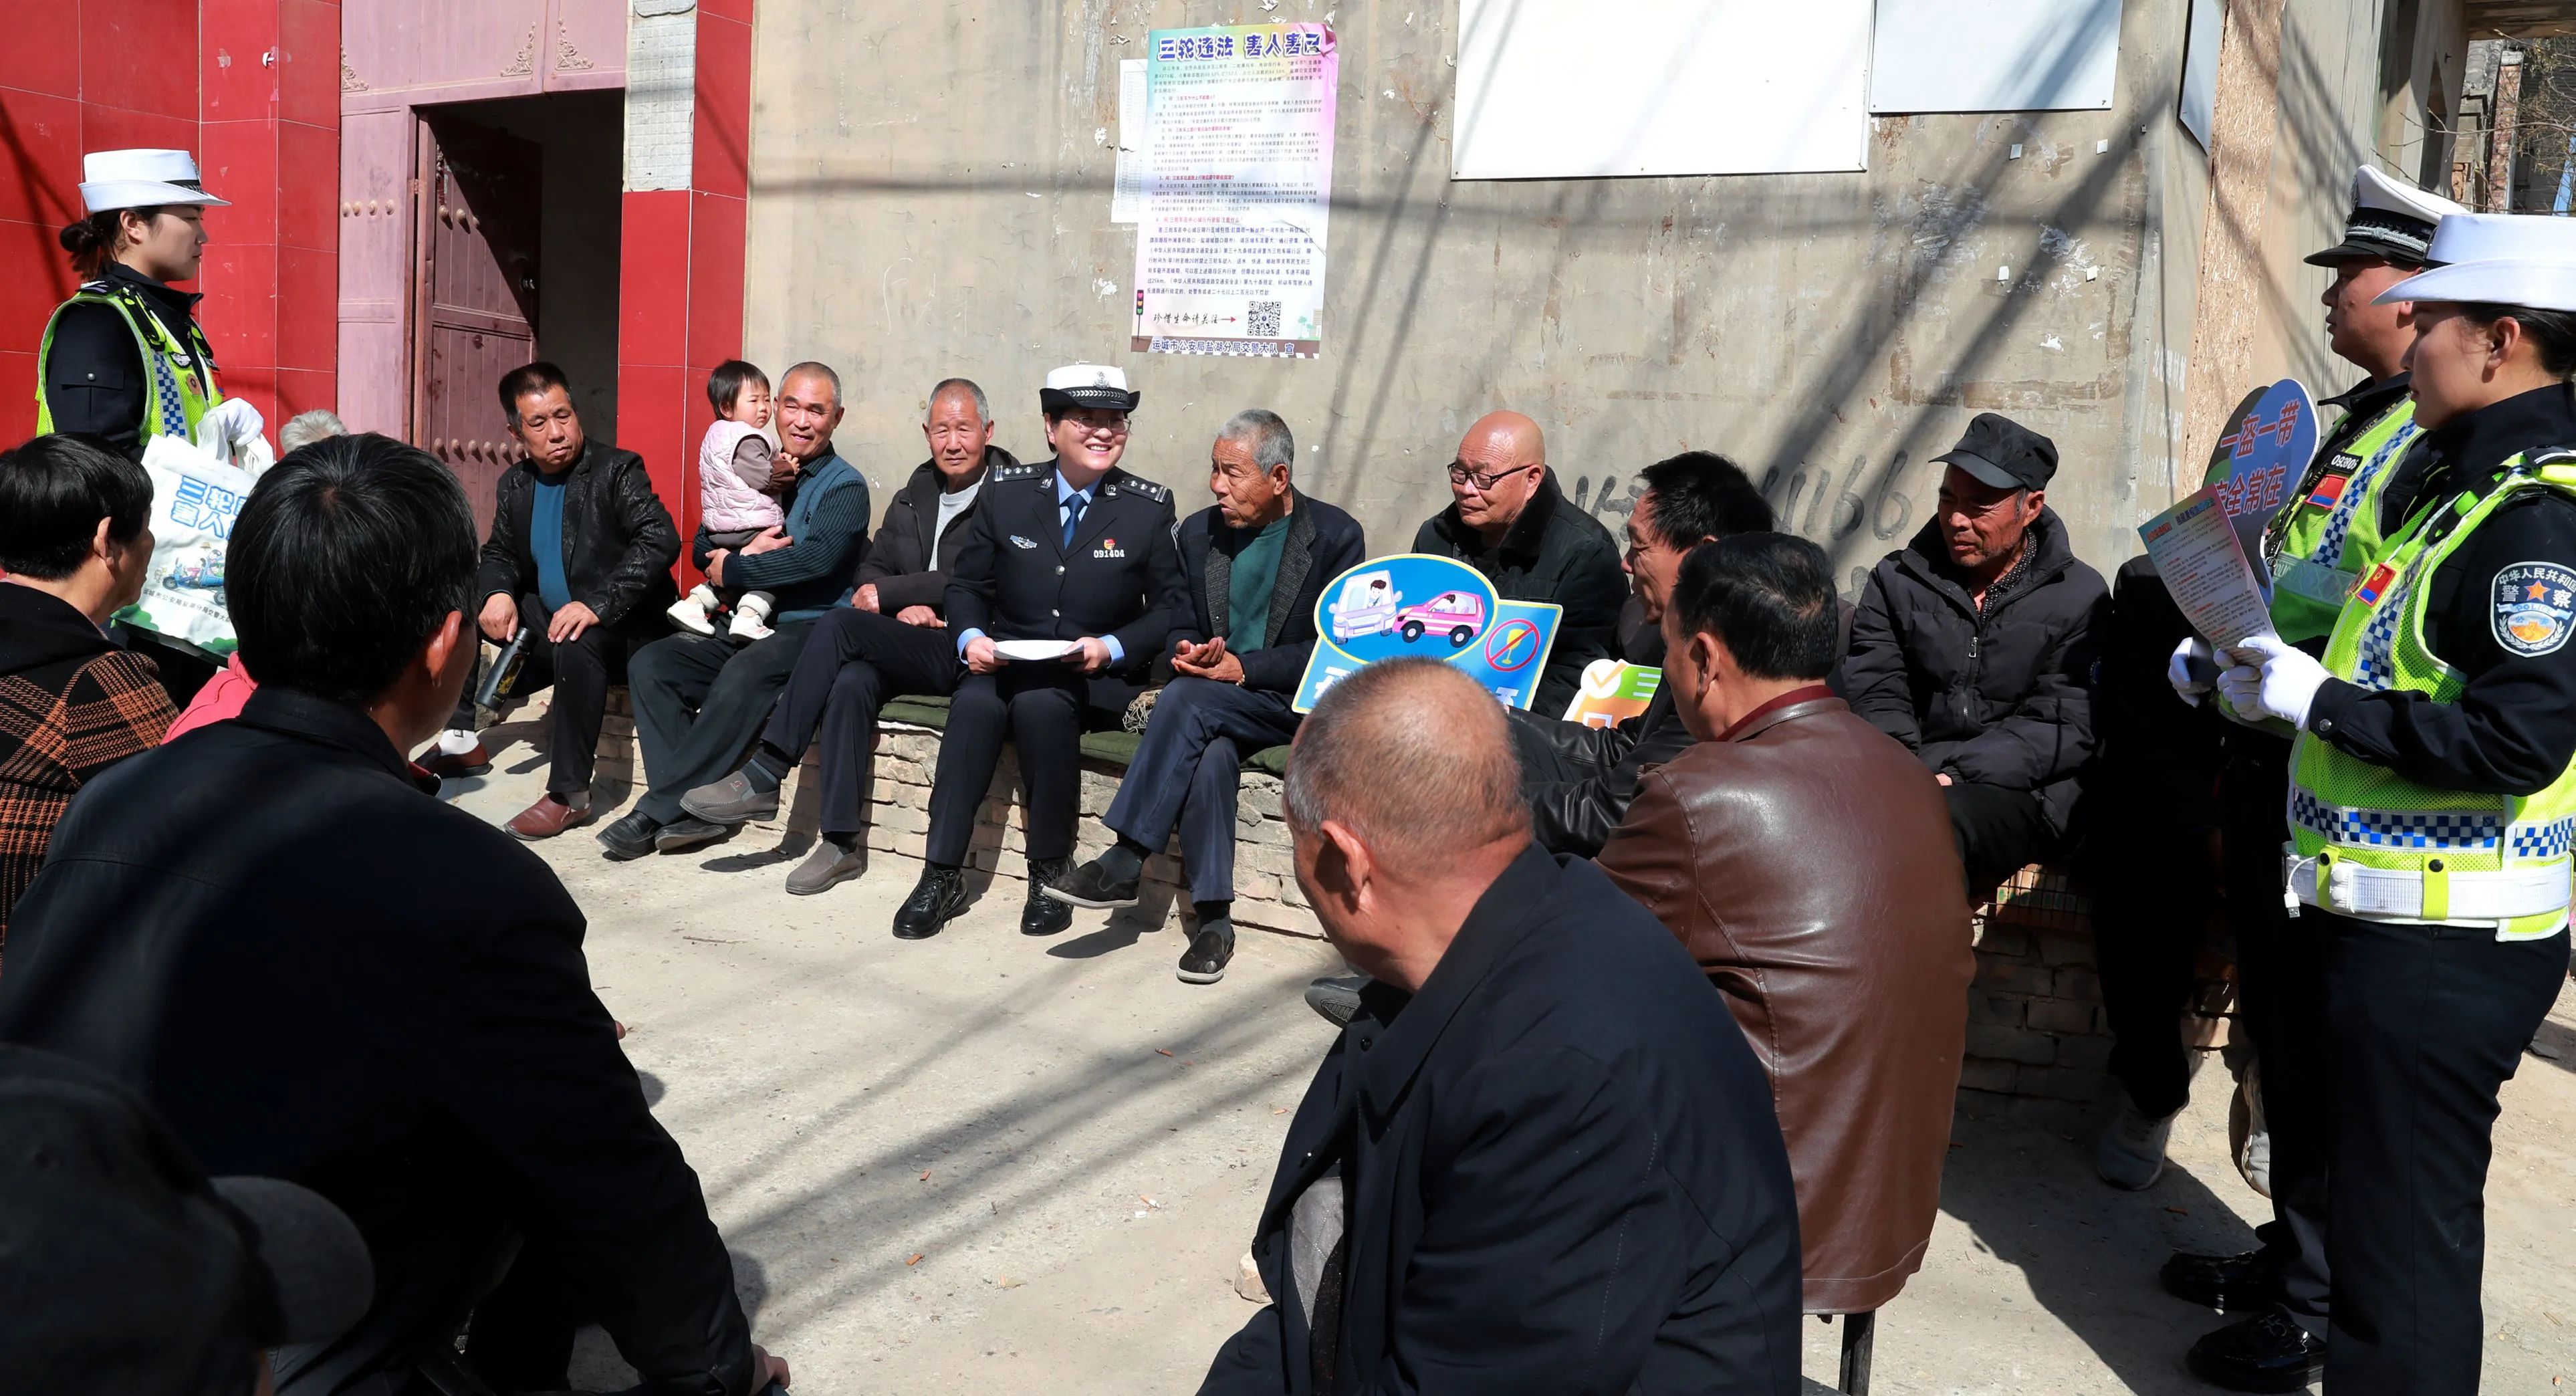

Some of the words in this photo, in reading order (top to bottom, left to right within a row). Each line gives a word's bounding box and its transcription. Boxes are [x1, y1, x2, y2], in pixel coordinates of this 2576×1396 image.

[1159, 35, 1234, 60] 三轮违法
[1246, 33, 1322, 57] 害人害己
[1153, 313, 1218, 325] 珍惜生命请关注
[1152, 340, 1278, 354] 运城市公安局盐湖分局交警大队
[1284, 343, 1295, 355] 宣
[2220, 398, 2301, 459] 一盔一带
[170, 500, 235, 541] 害人
[1093, 549, 1125, 558] 091404
[2498, 567, 2576, 593] 中华人民共和国
